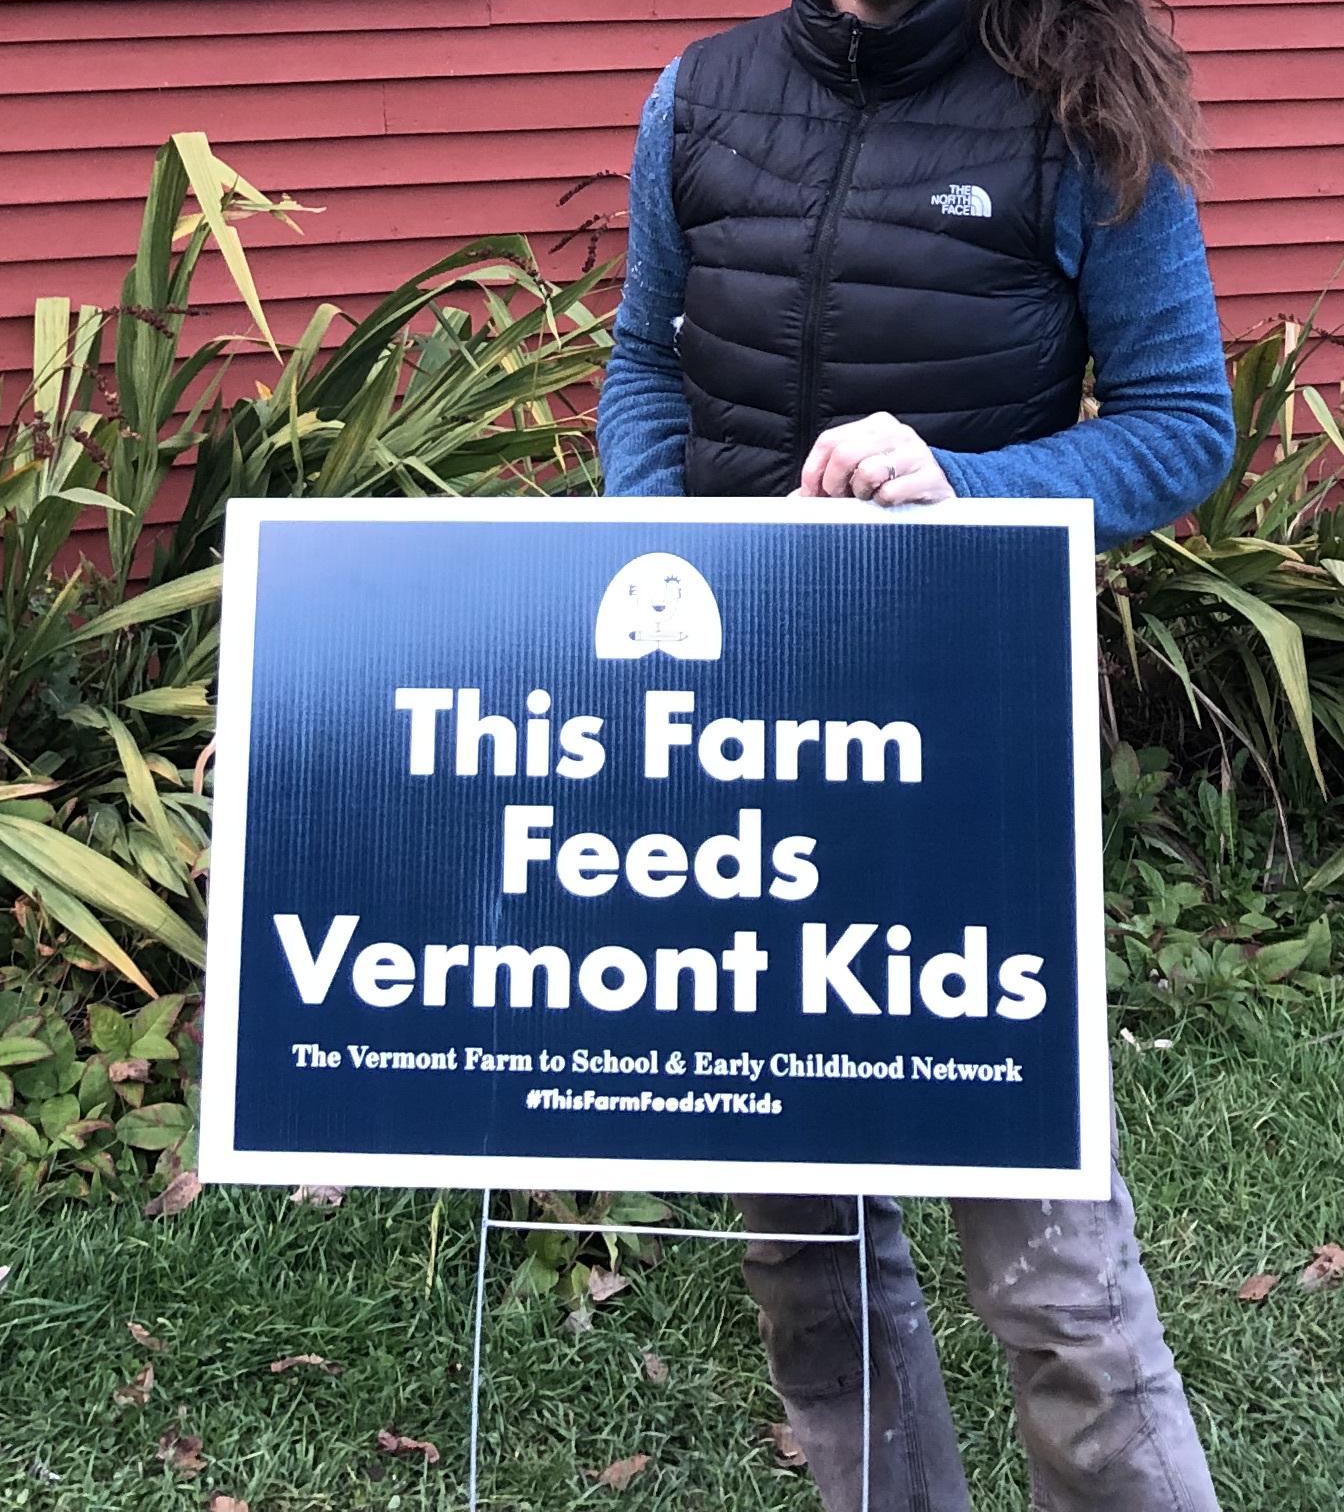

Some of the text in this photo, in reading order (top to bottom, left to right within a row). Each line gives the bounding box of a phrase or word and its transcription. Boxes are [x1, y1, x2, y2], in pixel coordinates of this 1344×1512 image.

[931, 194, 971, 205] NORTH
[949, 184, 971, 195] THE
[942, 205, 970, 216] FACE
[395, 687, 922, 783] This Farm
[502, 805, 819, 901] Feeds
[273, 914, 1047, 1020] Vermont Kids
[291, 1043, 1023, 1082] The Vermont Farm to School & Early Childhood Network
[525, 1088, 783, 1115] #ThisFarmFeedsVTKids
